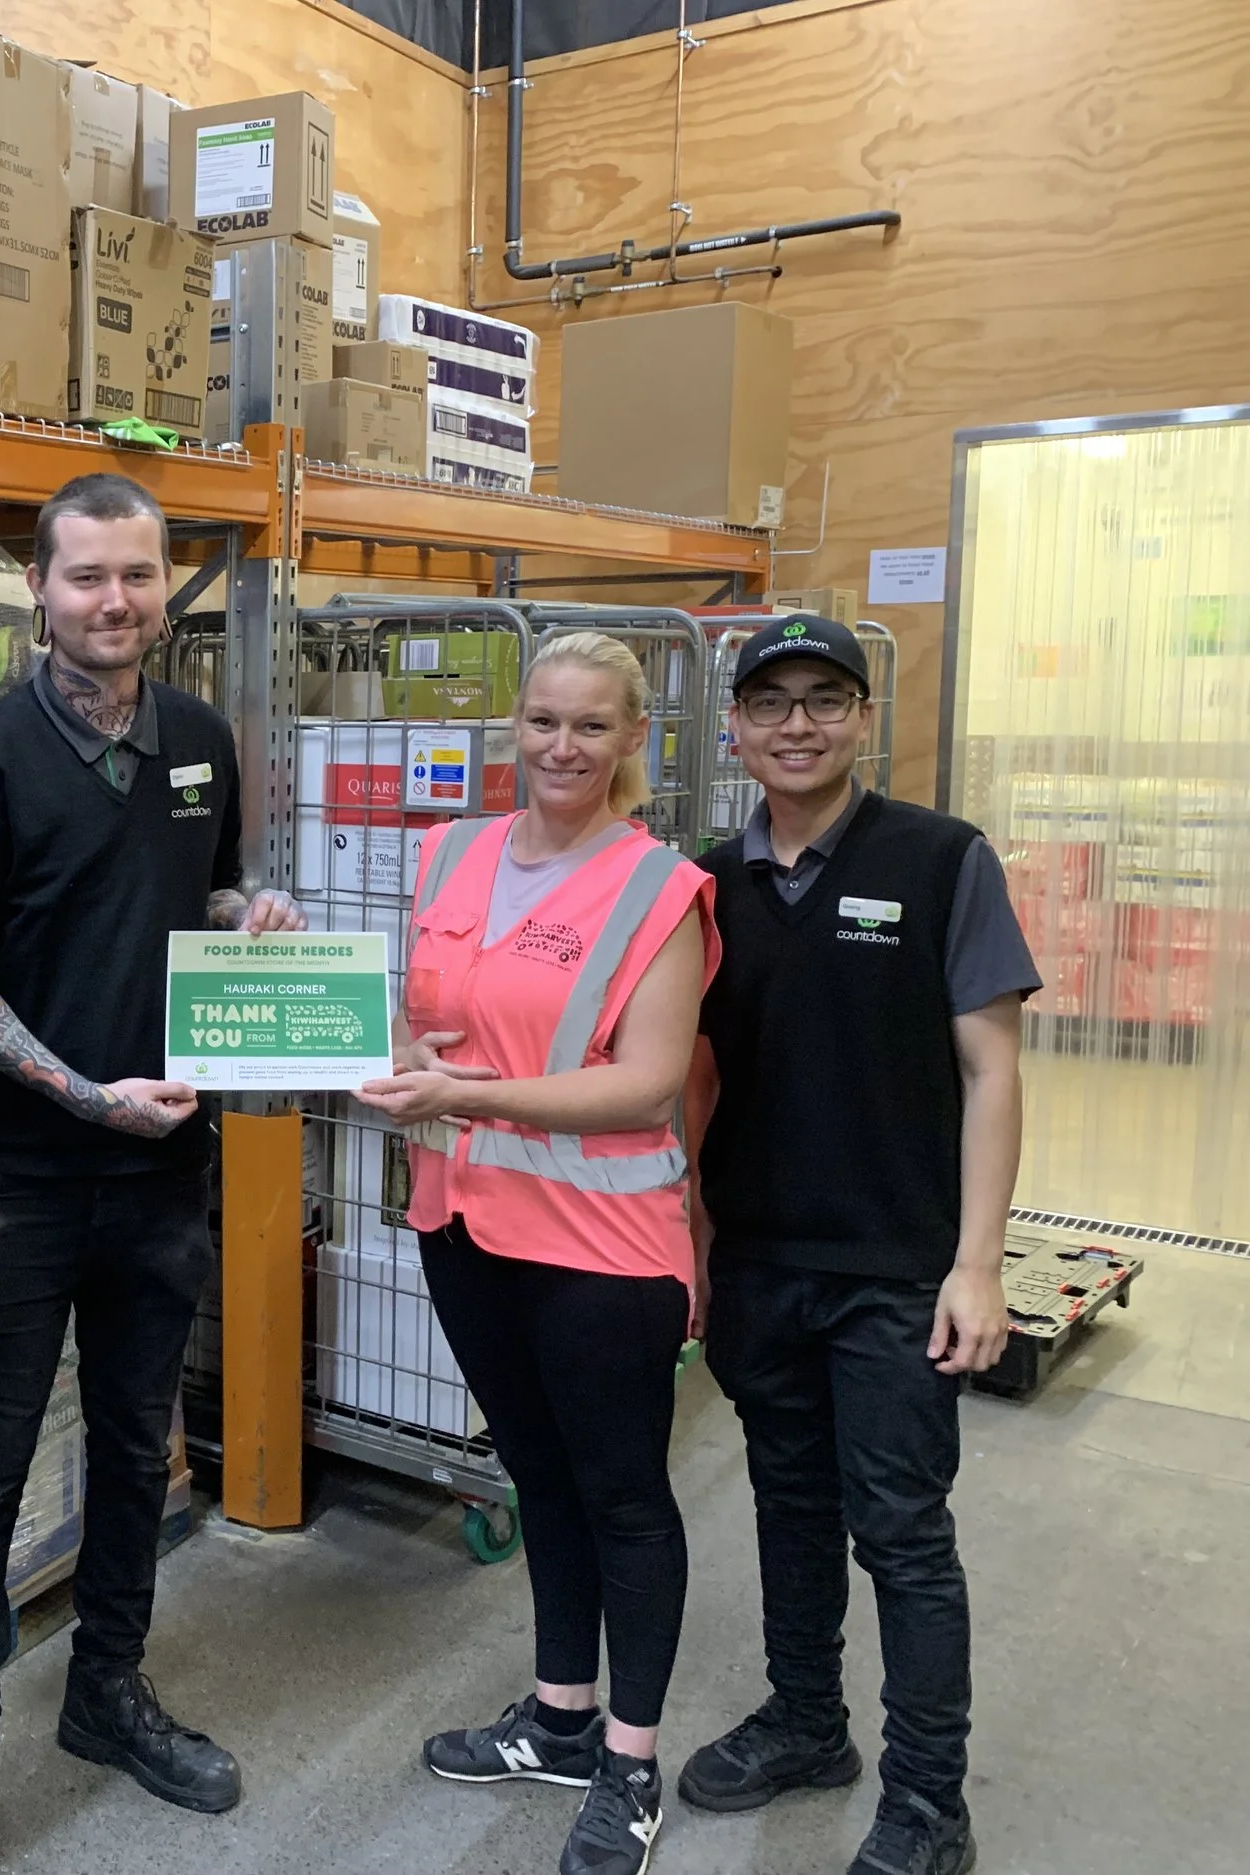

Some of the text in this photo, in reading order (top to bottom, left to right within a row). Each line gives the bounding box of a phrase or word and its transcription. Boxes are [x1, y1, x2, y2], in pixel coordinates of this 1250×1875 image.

[245, 120, 271, 129] ECOLAB
[13, 163, 33, 179] MASK
[197, 211, 269, 233] ECOLAB
[302, 285, 328, 305] COLAB
[100, 306, 128, 326] BLUE
[333, 321, 366, 341] COLAB
[758, 635, 830, 658] countdown
[171, 805, 212, 818] countdown
[375, 853, 401, 868] 750mL
[836, 930, 900, 946] countdown
[204, 945, 353, 957] FOOD RESCUE HEROES
[223, 984, 326, 994] HAURAKI CORNER
[190, 1003, 278, 1023] THANK
[290, 1017, 352, 1025] KIWIHARVEST
[190, 1028, 276, 1048] YOU FROM
